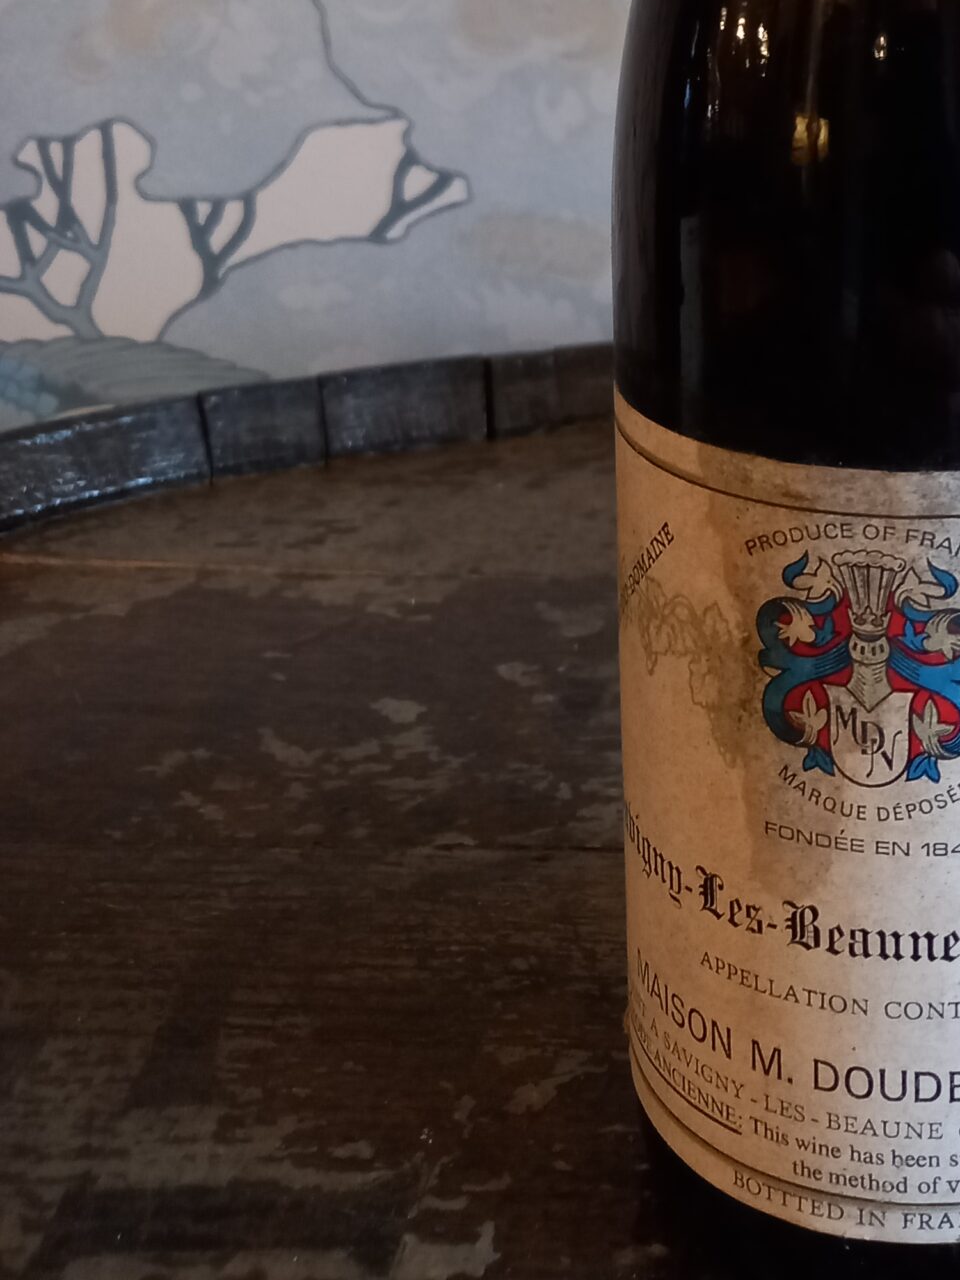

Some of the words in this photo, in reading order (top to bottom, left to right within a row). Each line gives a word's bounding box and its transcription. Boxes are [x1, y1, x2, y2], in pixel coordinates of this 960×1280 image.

[744, 523, 852, 556] PRODUCE
[862, 524, 896, 540] OF
[778, 764, 867, 821] MARQUE
[764, 821, 865, 853] FONDÉE
[875, 840, 910, 856] EN
[700, 951, 869, 1017] APPELLATION
[637, 948, 732, 1061] MAISON
[751, 1039, 794, 1085] M.
[749, 1116, 790, 1146] This
[795, 1136, 841, 1160] wine
[850, 1145, 885, 1165] has
[892, 1149, 940, 1168] been
[792, 1159, 823, 1181] the
[828, 1171, 908, 1194] method
[918, 1176, 941, 1194] of
[856, 1208, 886, 1227] IN
